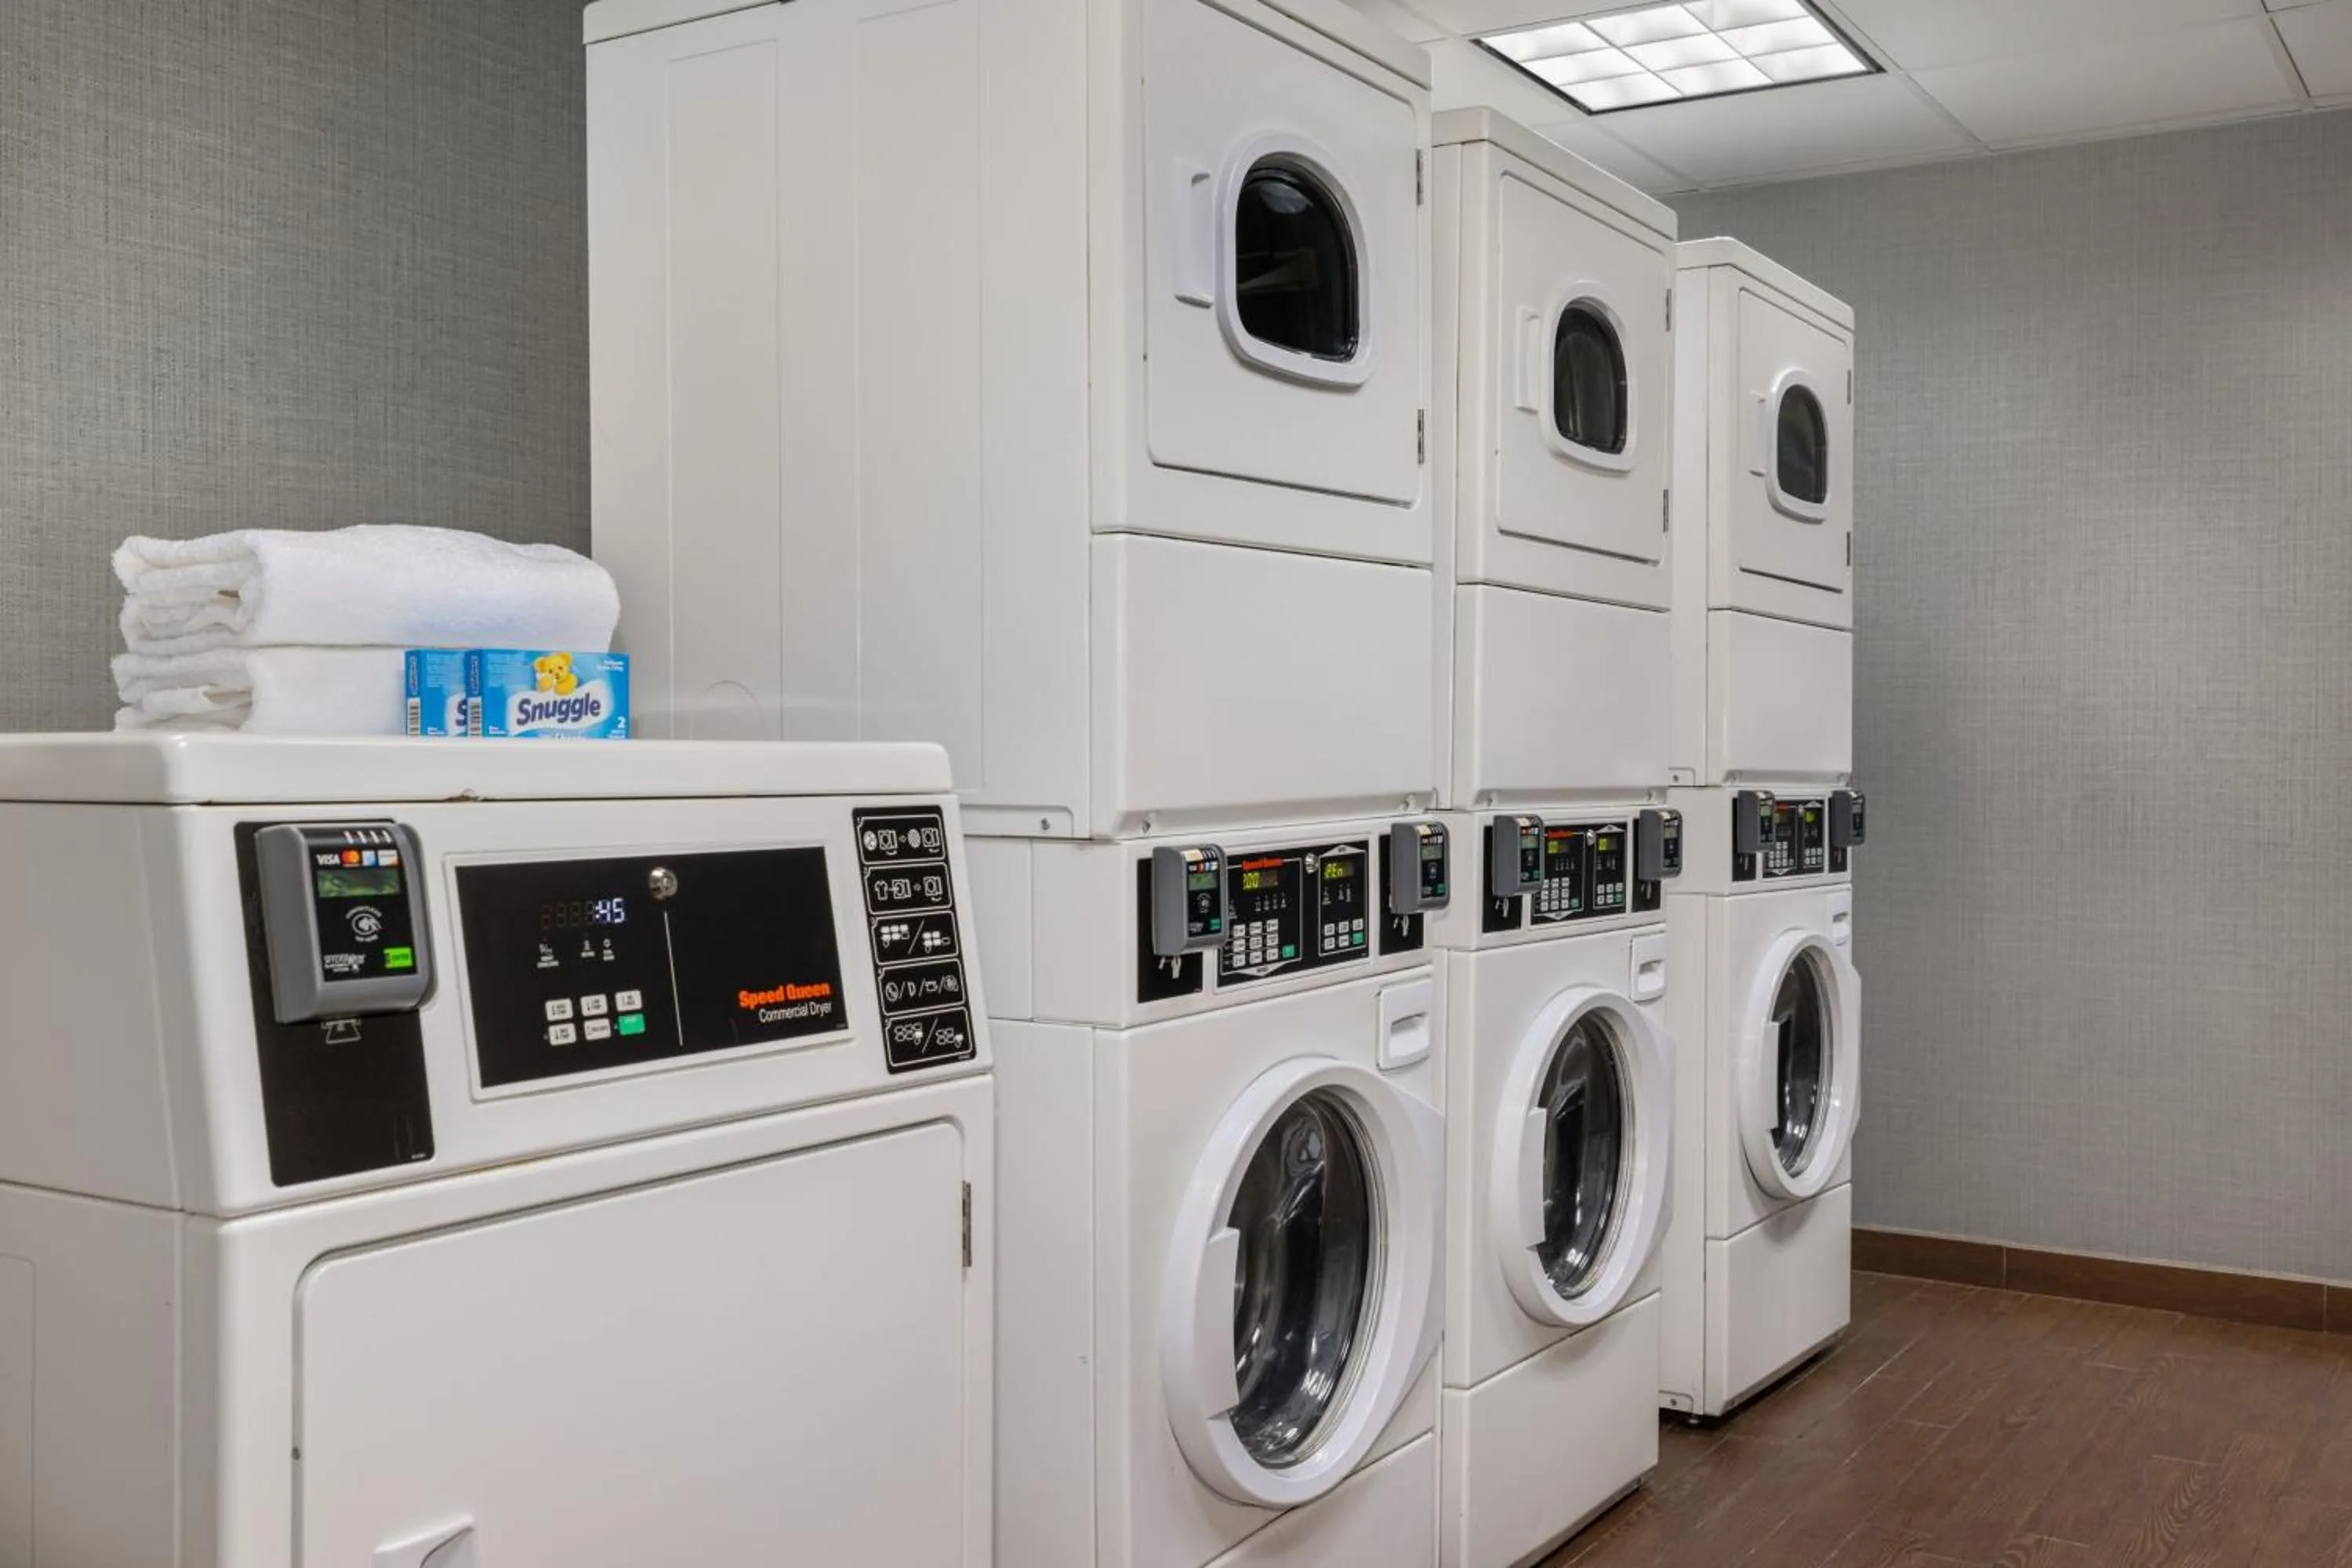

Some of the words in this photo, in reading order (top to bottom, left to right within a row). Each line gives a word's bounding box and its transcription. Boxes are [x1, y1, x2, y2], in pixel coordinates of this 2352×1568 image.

[516, 693, 601, 726] Snuggle
[617, 717, 626, 728] 2
[316, 854, 340, 865] VISA
[739, 985, 784, 1010] Speed
[786, 982, 830, 1000] Queen
[758, 1003, 808, 1023] Commercial
[809, 1001, 832, 1017] Dryer
